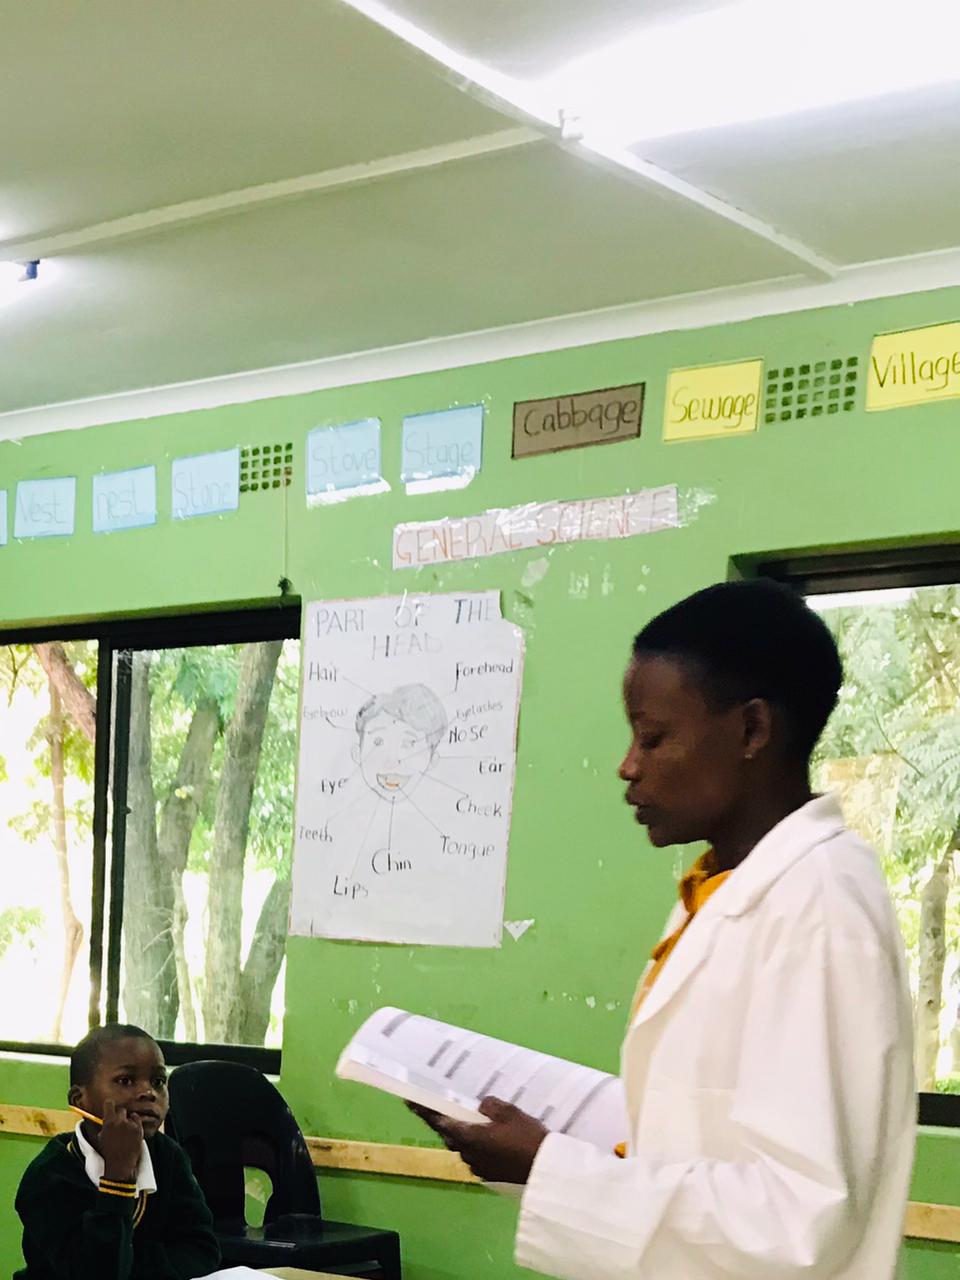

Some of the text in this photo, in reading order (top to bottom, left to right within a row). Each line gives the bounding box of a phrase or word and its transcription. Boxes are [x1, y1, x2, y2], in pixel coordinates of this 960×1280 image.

[871, 352, 960, 393] Village
[523, 403, 637, 440] Cabbage
[672, 390, 756, 427] Sewage
[312, 442, 378, 478] Stove
[404, 430, 476, 468] Stage
[17, 486, 67, 525] Vest
[96, 477, 146, 521] nest
[395, 517, 522, 565] GENERAL
[393, 602, 428, 629] OF
[453, 596, 497, 625] THE
[308, 660, 340, 683] Hair
[455, 658, 515, 679] Forehead
[456, 796, 503, 818] Cheek
[371, 848, 413, 876] Chin
[440, 835, 496, 860] Tongue
[333, 874, 370, 900] Lips
